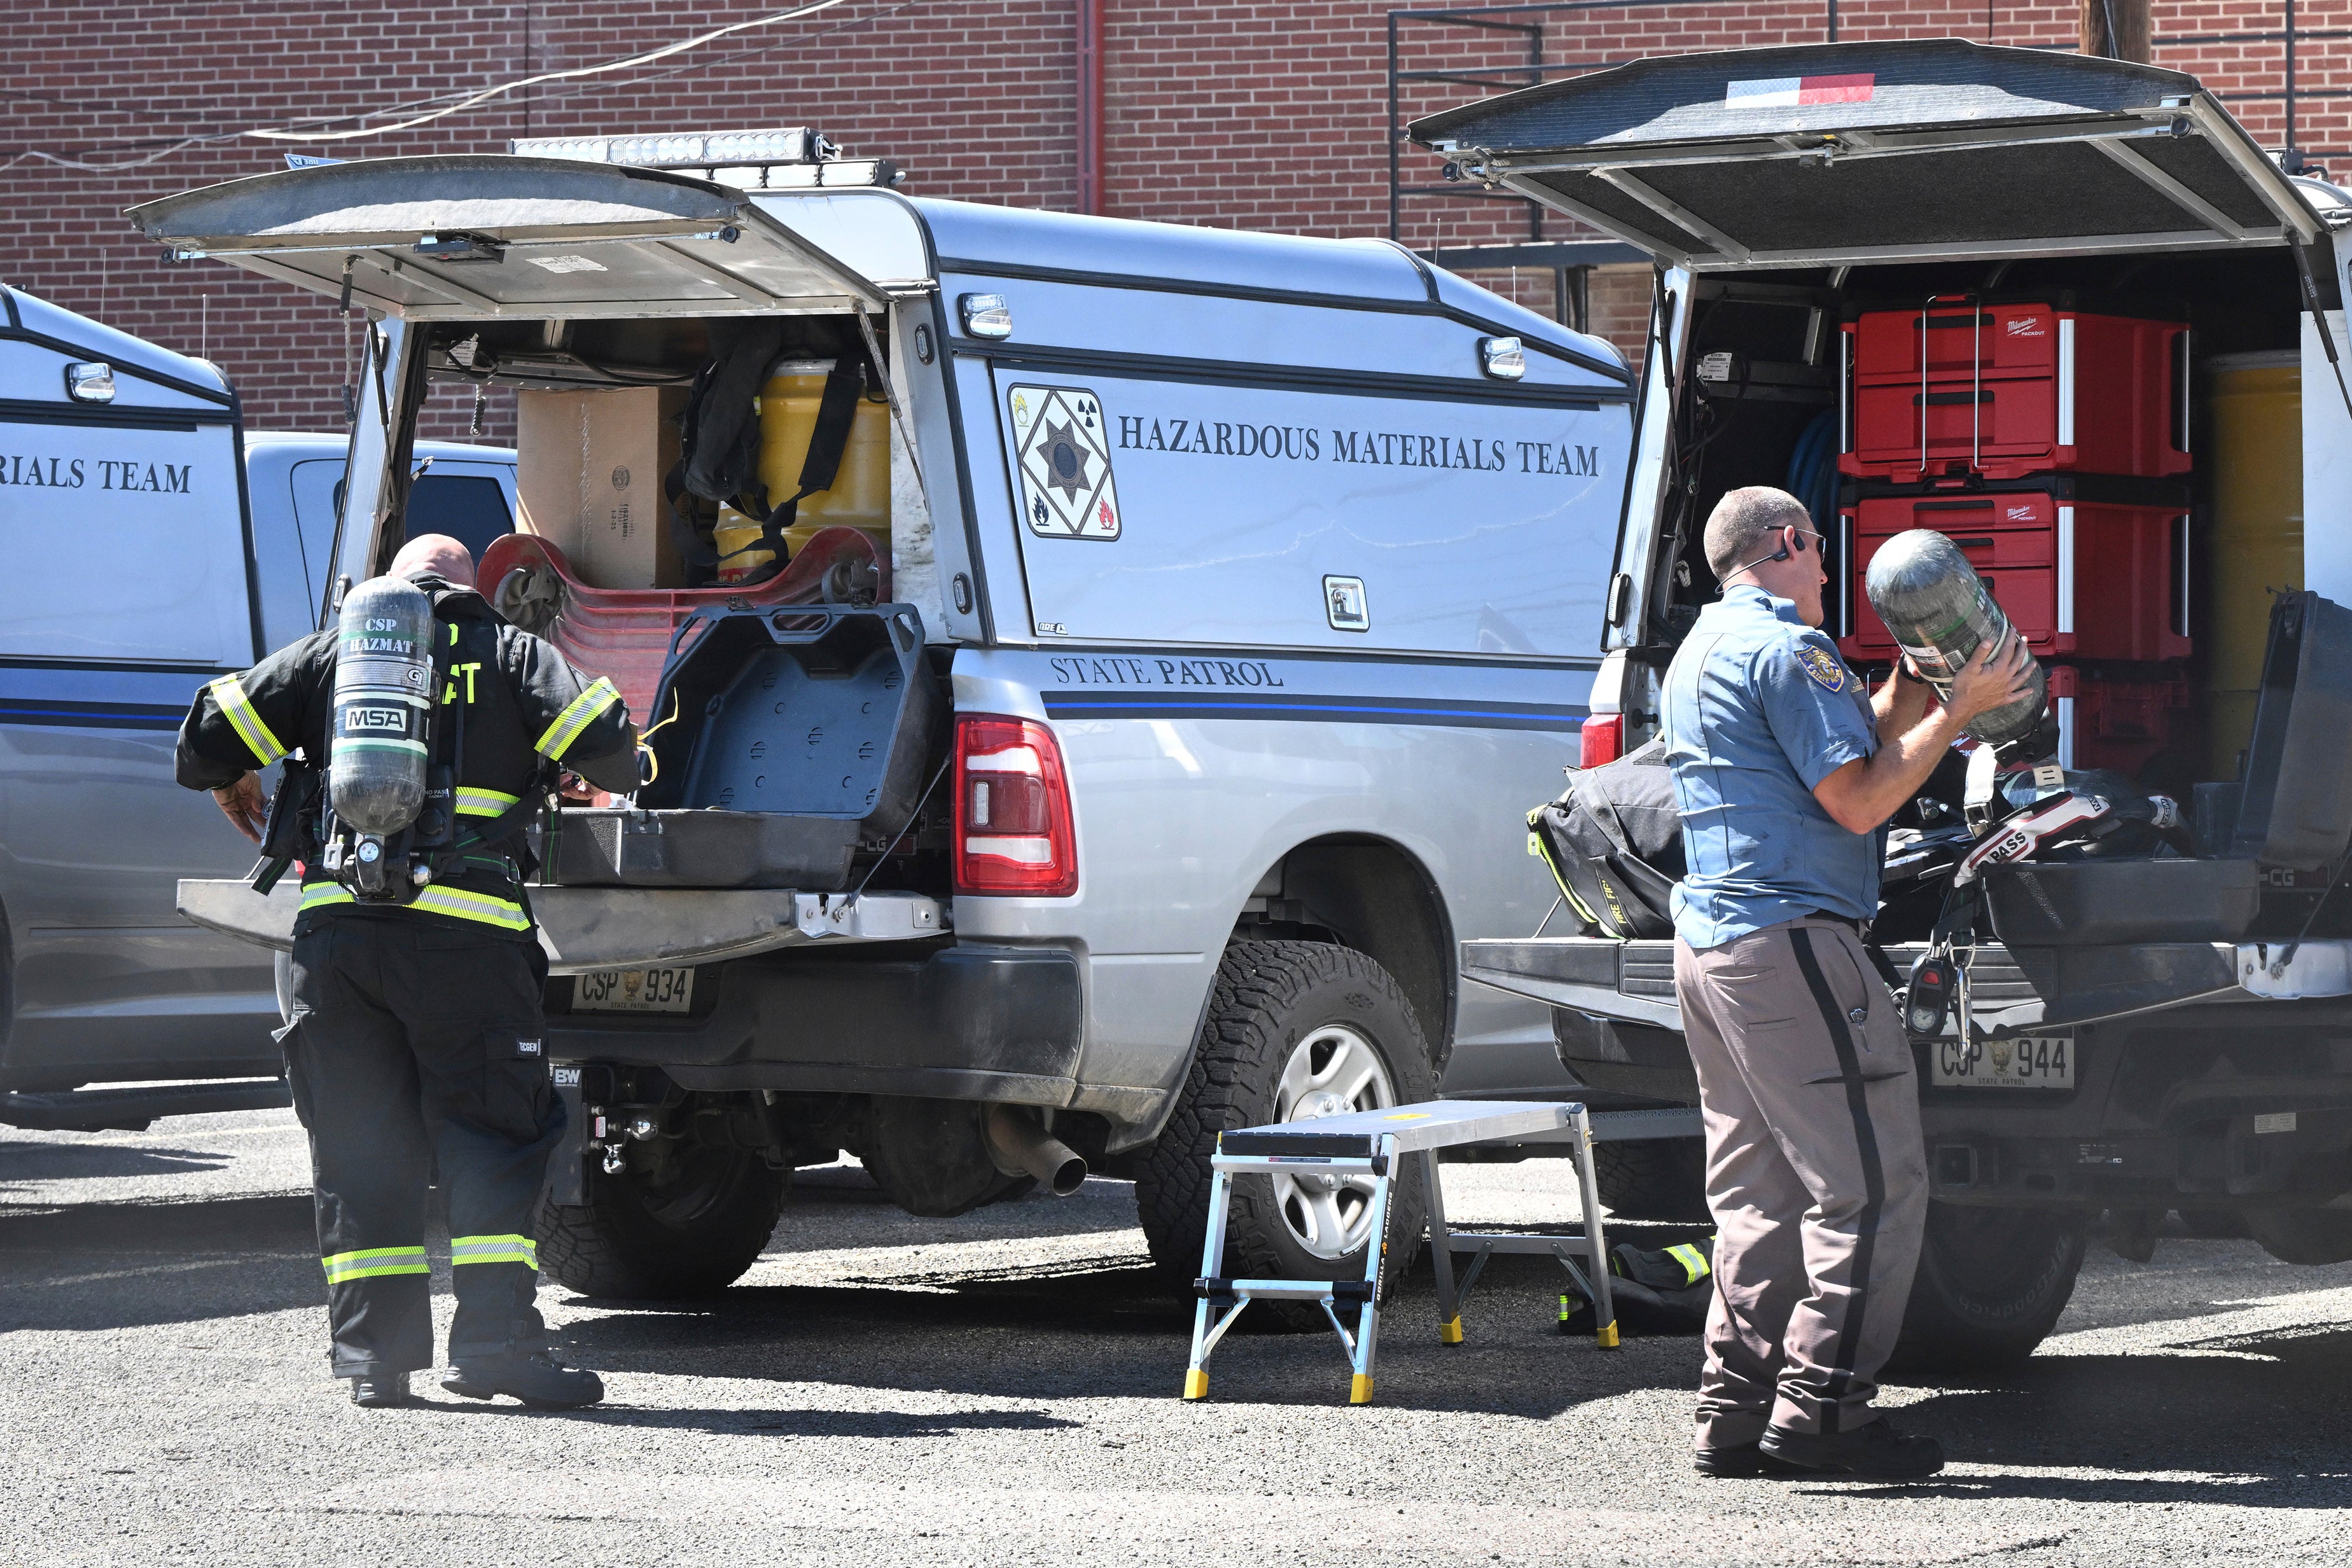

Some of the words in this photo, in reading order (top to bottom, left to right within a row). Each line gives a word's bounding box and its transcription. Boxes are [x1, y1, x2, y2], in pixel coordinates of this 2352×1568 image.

[2007, 317, 2036, 332] Milwaukee
[1118, 415, 1319, 461] HAZARDOUS
[1332, 430, 1505, 471] MATERIALS
[1517, 441, 1599, 476] TEAM
[98, 460, 192, 493] TEAM
[365, 618, 397, 632] CSP
[349, 637, 413, 653] HAZMAT
[1050, 658, 1152, 684] STATE
[1154, 660, 1284, 687] PATROL
[349, 710, 403, 728] MSA
[1989, 832, 2026, 861] PASS
[1610, 903, 1627, 924] FIRE
[582, 972, 618, 1001] CSP
[645, 969, 686, 1003] 934
[1941, 1041, 1982, 1076] CSP
[2018, 1039, 2066, 1078] 944
[1384, 1191, 1393, 1238] LADDERS
